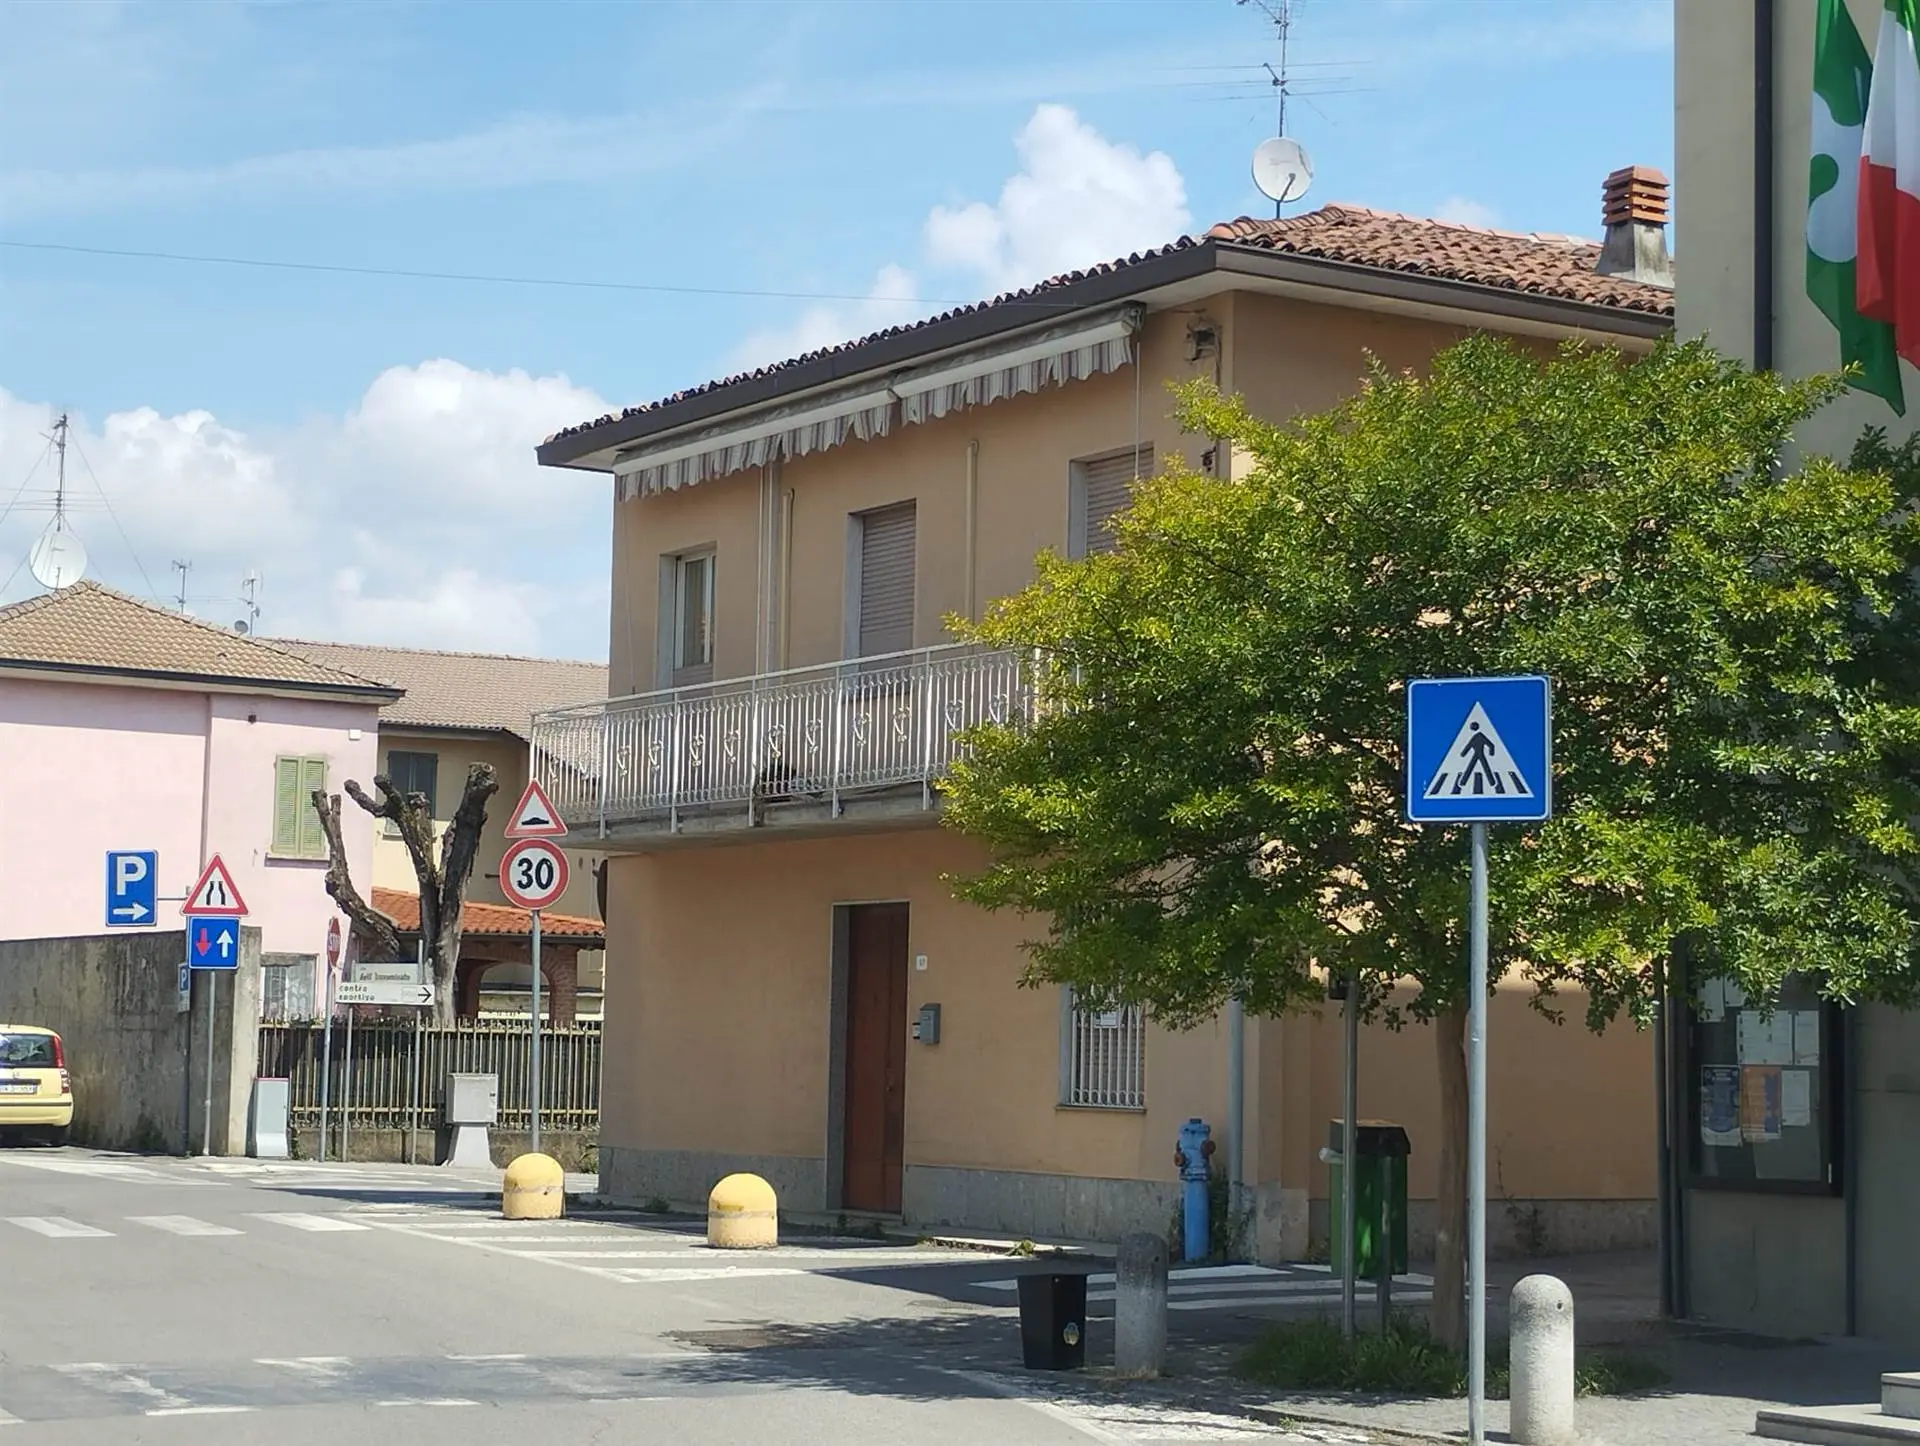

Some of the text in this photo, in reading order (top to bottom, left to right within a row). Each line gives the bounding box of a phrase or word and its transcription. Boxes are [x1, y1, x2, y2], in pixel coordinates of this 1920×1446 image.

[116, 856, 147, 895] P
[517, 857, 554, 890] 30
[180, 969, 188, 988] P
